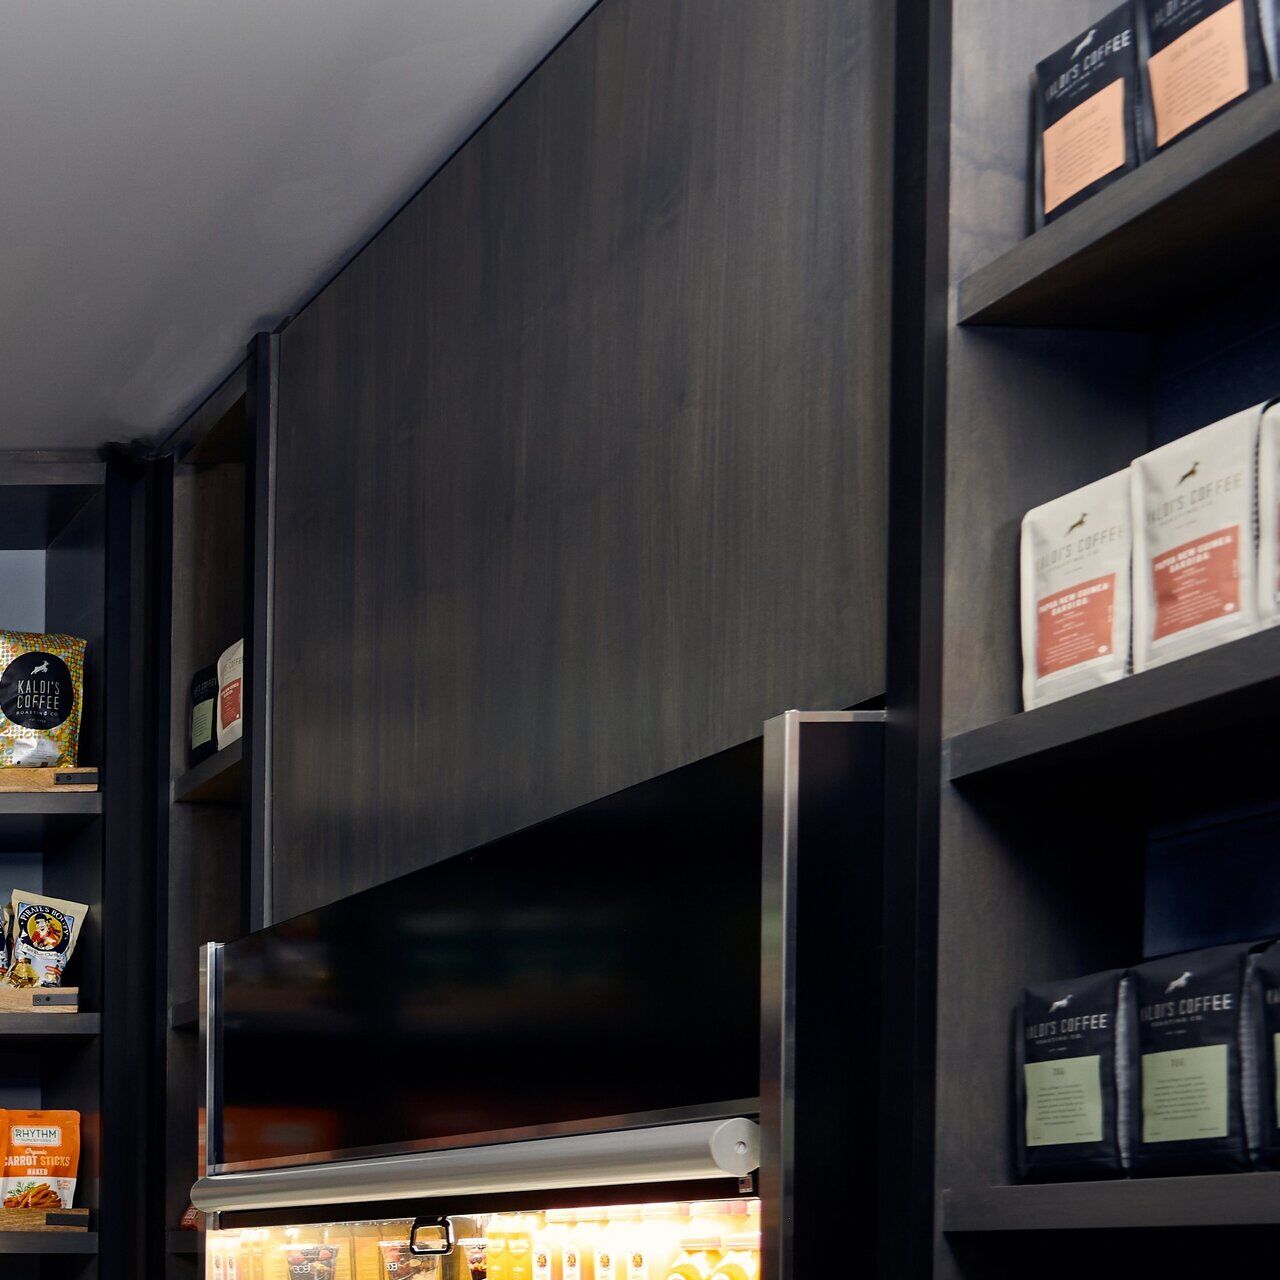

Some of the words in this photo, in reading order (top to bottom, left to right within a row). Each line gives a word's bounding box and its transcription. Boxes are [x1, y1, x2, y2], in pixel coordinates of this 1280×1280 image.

[17, 695, 59, 710] COFFEE
[1179, 994, 1232, 1015] COFFEE
[1061, 1014, 1108, 1033] COFFEE
[41, 1155, 70, 1167] STICKS
